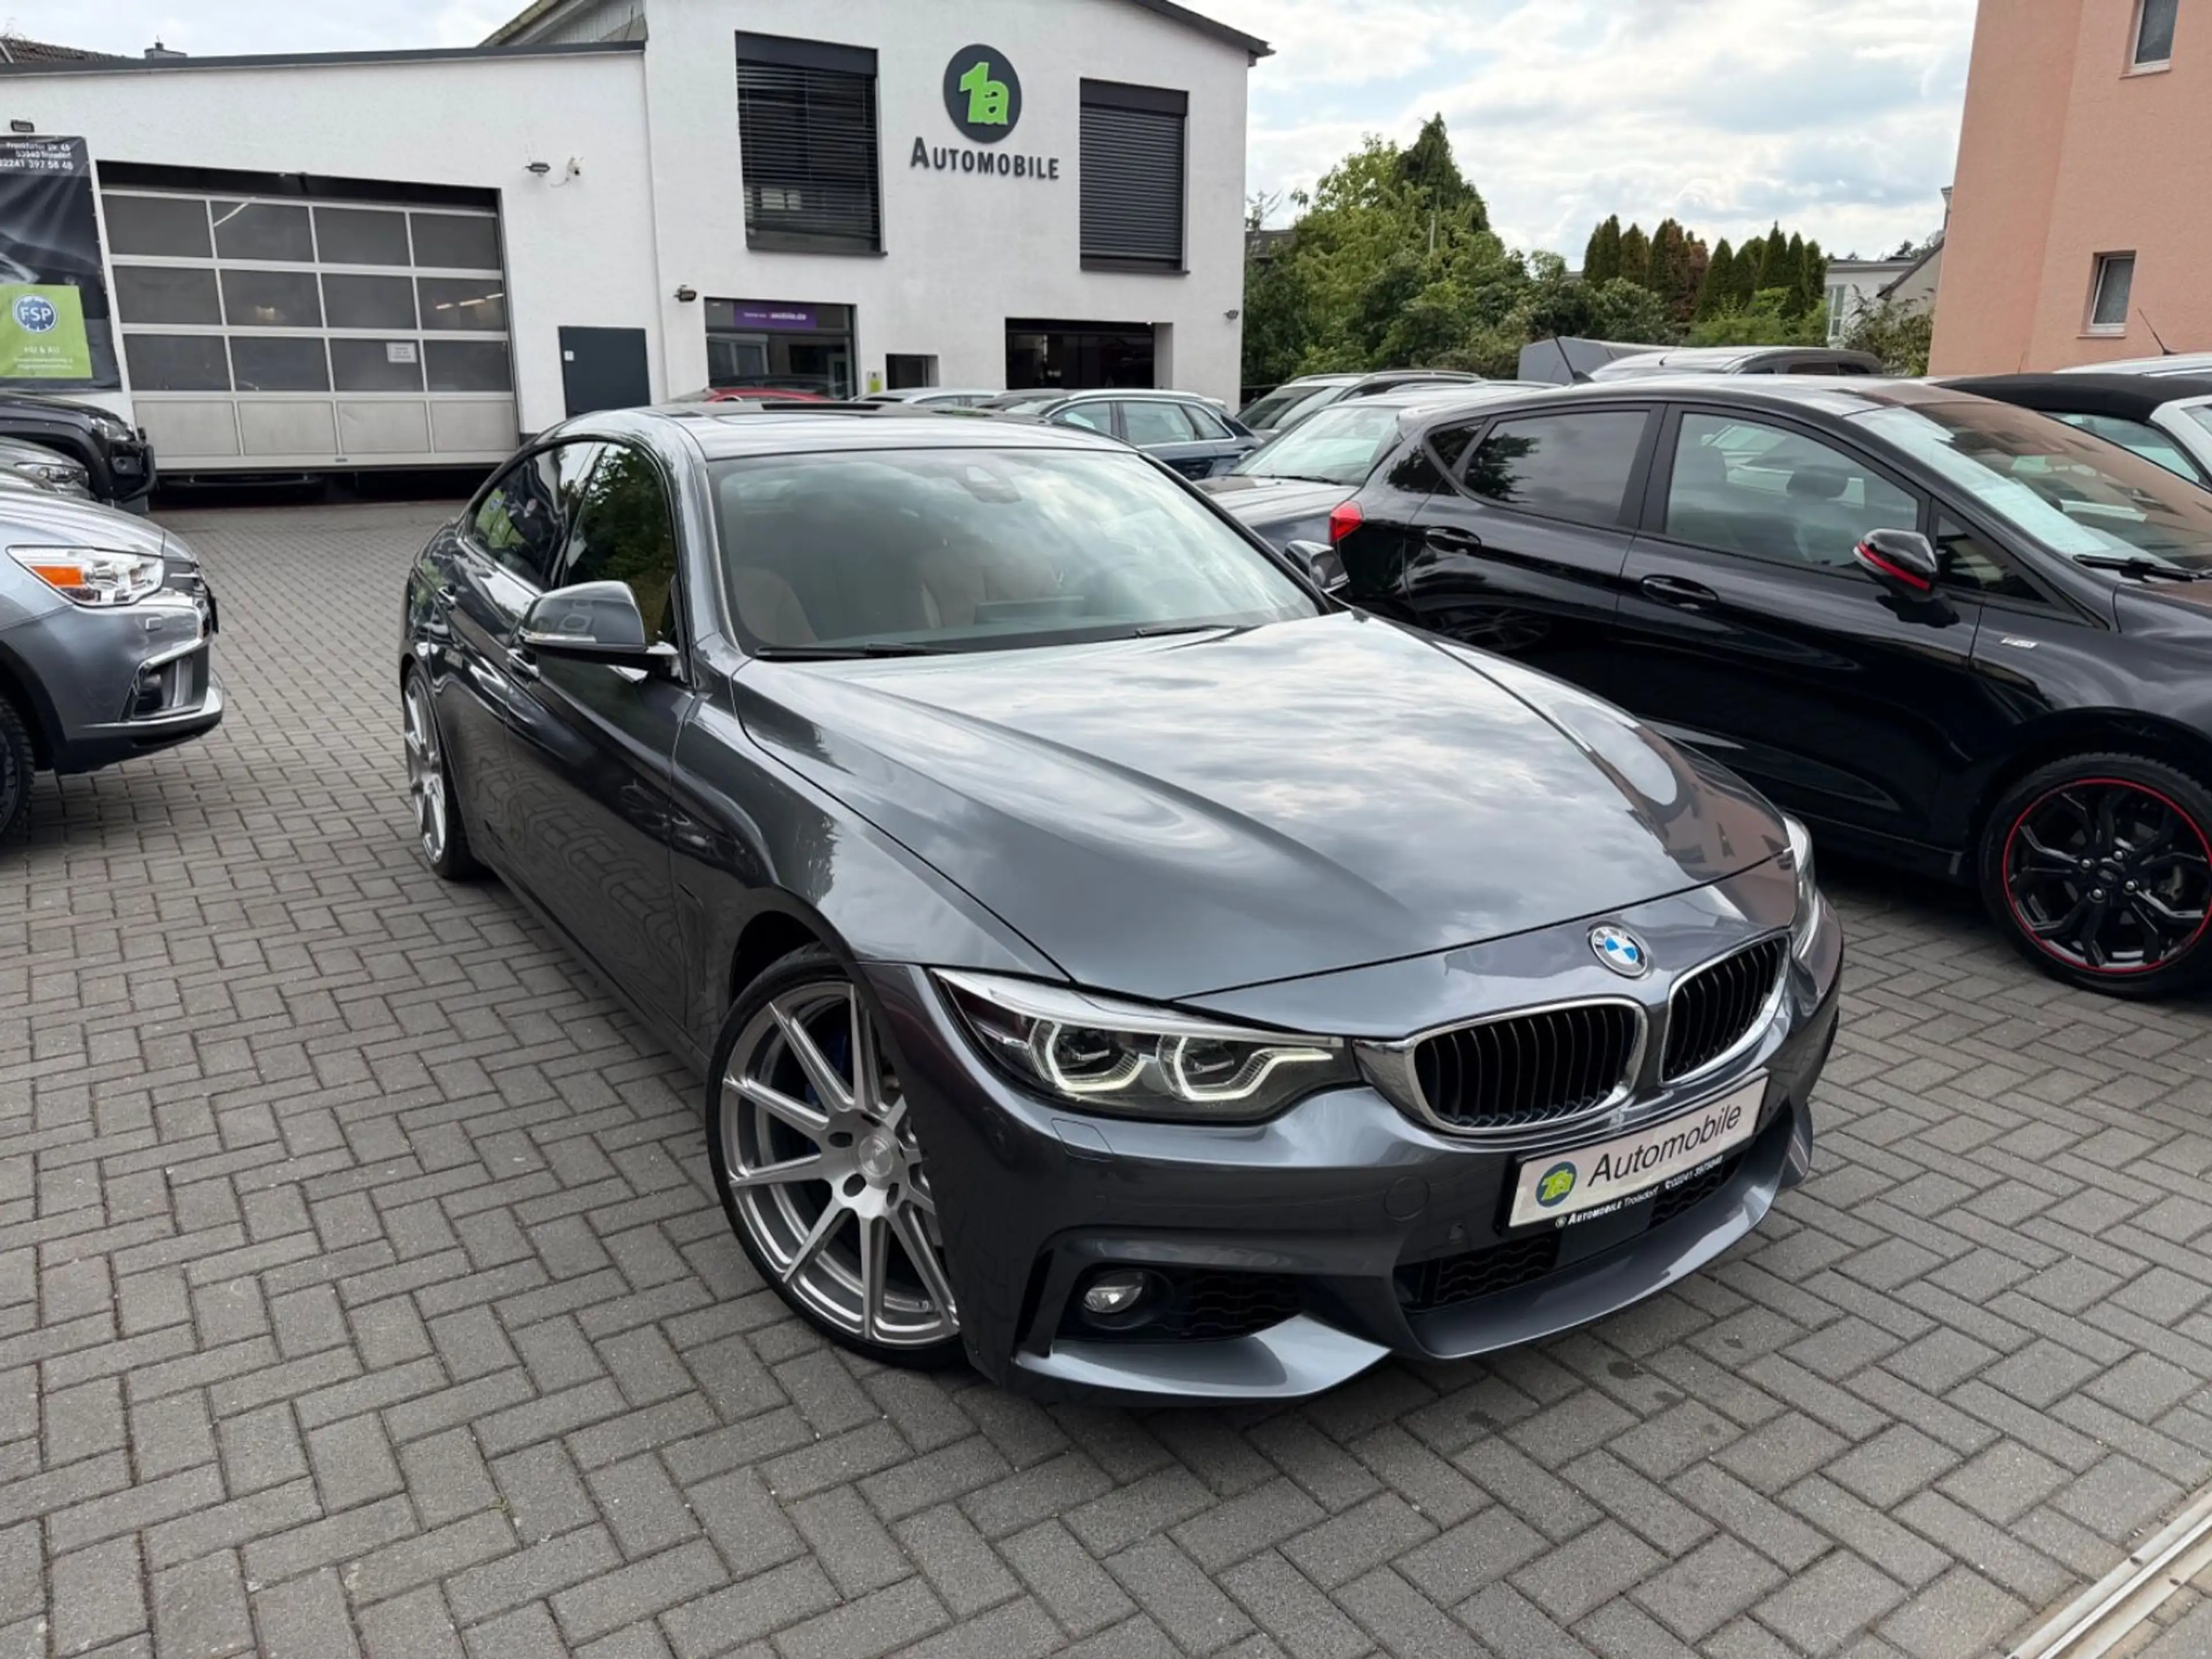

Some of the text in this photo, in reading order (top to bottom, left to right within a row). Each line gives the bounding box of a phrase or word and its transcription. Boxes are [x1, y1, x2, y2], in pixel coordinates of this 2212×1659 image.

[959, 62, 1009, 125] 1a
[910, 137, 1059, 180] AUTOMOBILE
[20, 306, 52, 321] FSP
[1587, 1104, 1741, 1187] Automobile
